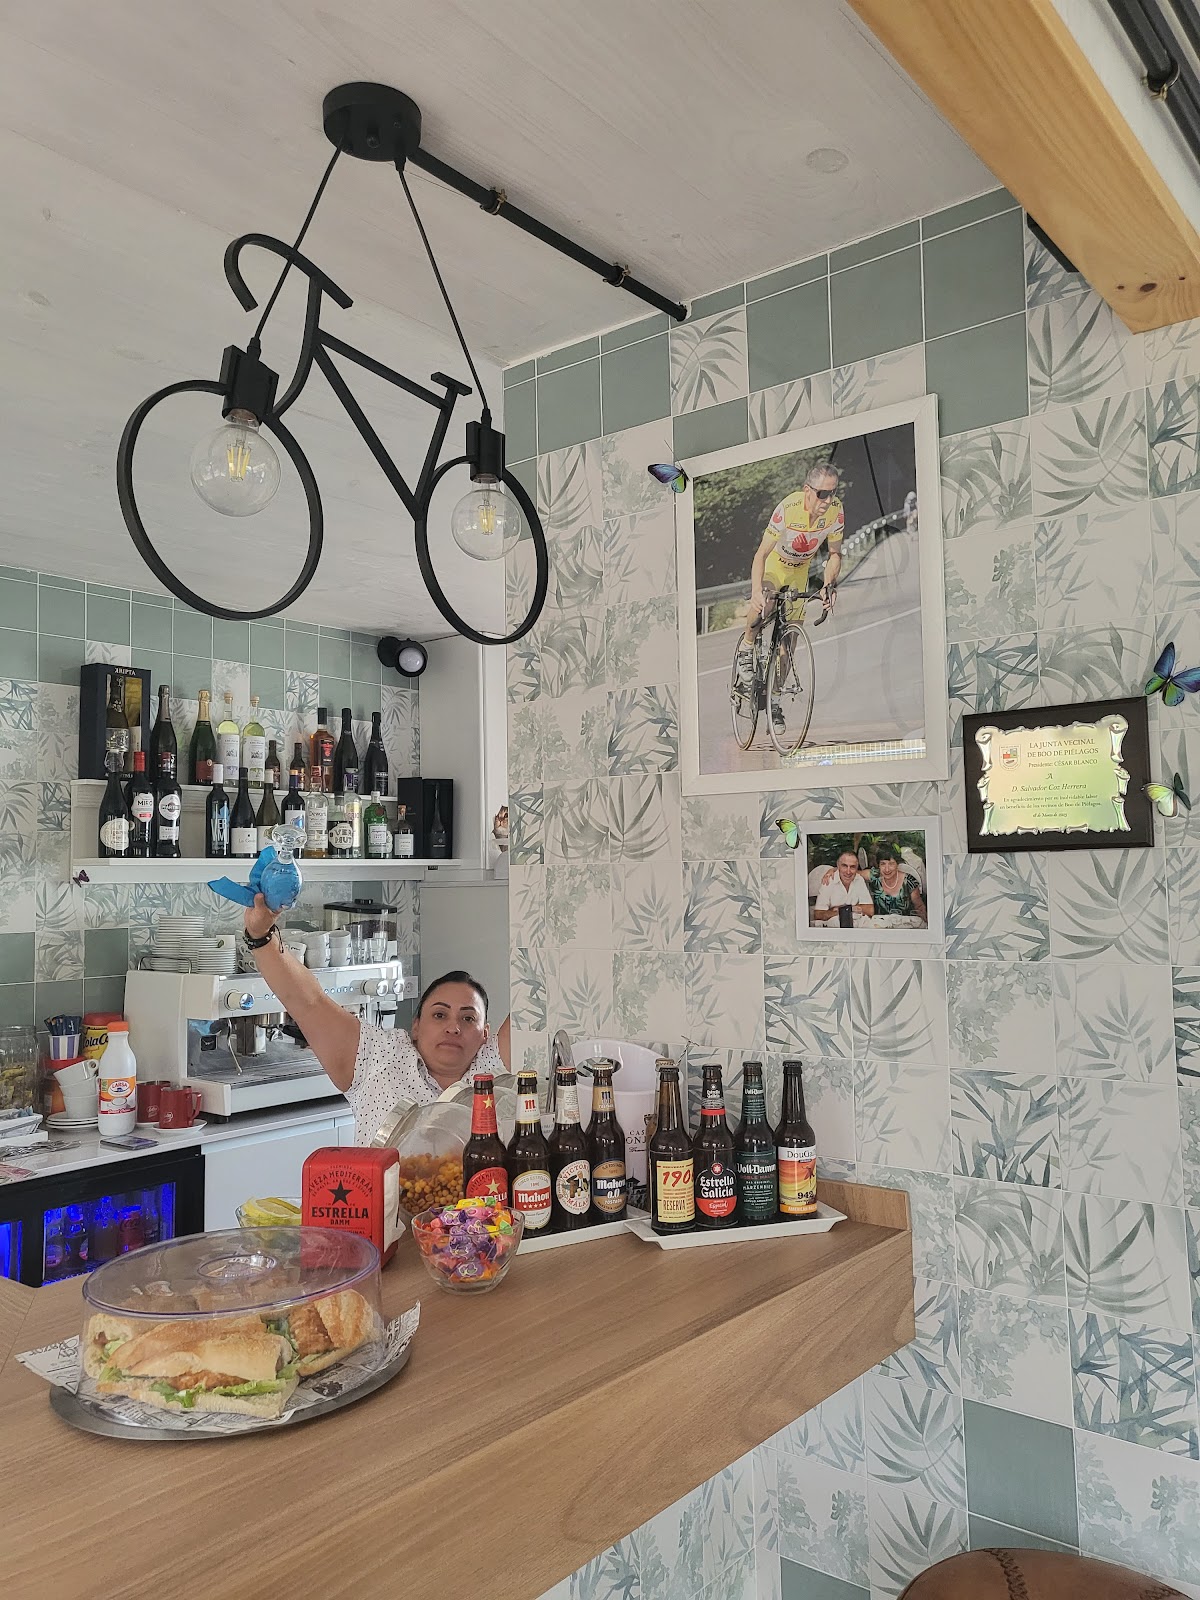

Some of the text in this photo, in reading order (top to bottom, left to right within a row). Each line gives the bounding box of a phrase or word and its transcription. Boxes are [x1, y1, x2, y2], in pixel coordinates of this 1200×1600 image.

[1038, 741, 1063, 749] JUNTA
[1063, 738, 1096, 746] VECINAL
[1053, 749, 1063, 757] DE
[1064, 747, 1099, 756] PIÉLAGOS
[1053, 759, 1073, 767] CÉSAR
[1019, 784, 1048, 792] Salvador
[1061, 782, 1087, 790] Herrera
[700, 1175, 735, 1187] Estrella
[518, 1191, 550, 1203] Mahou
[701, 1186, 734, 1198] Galicia
[797, 1190, 814, 1200] 942
[662, 1199, 686, 1211] RESERVA
[311, 1206, 369, 1219] ESTRELLA
